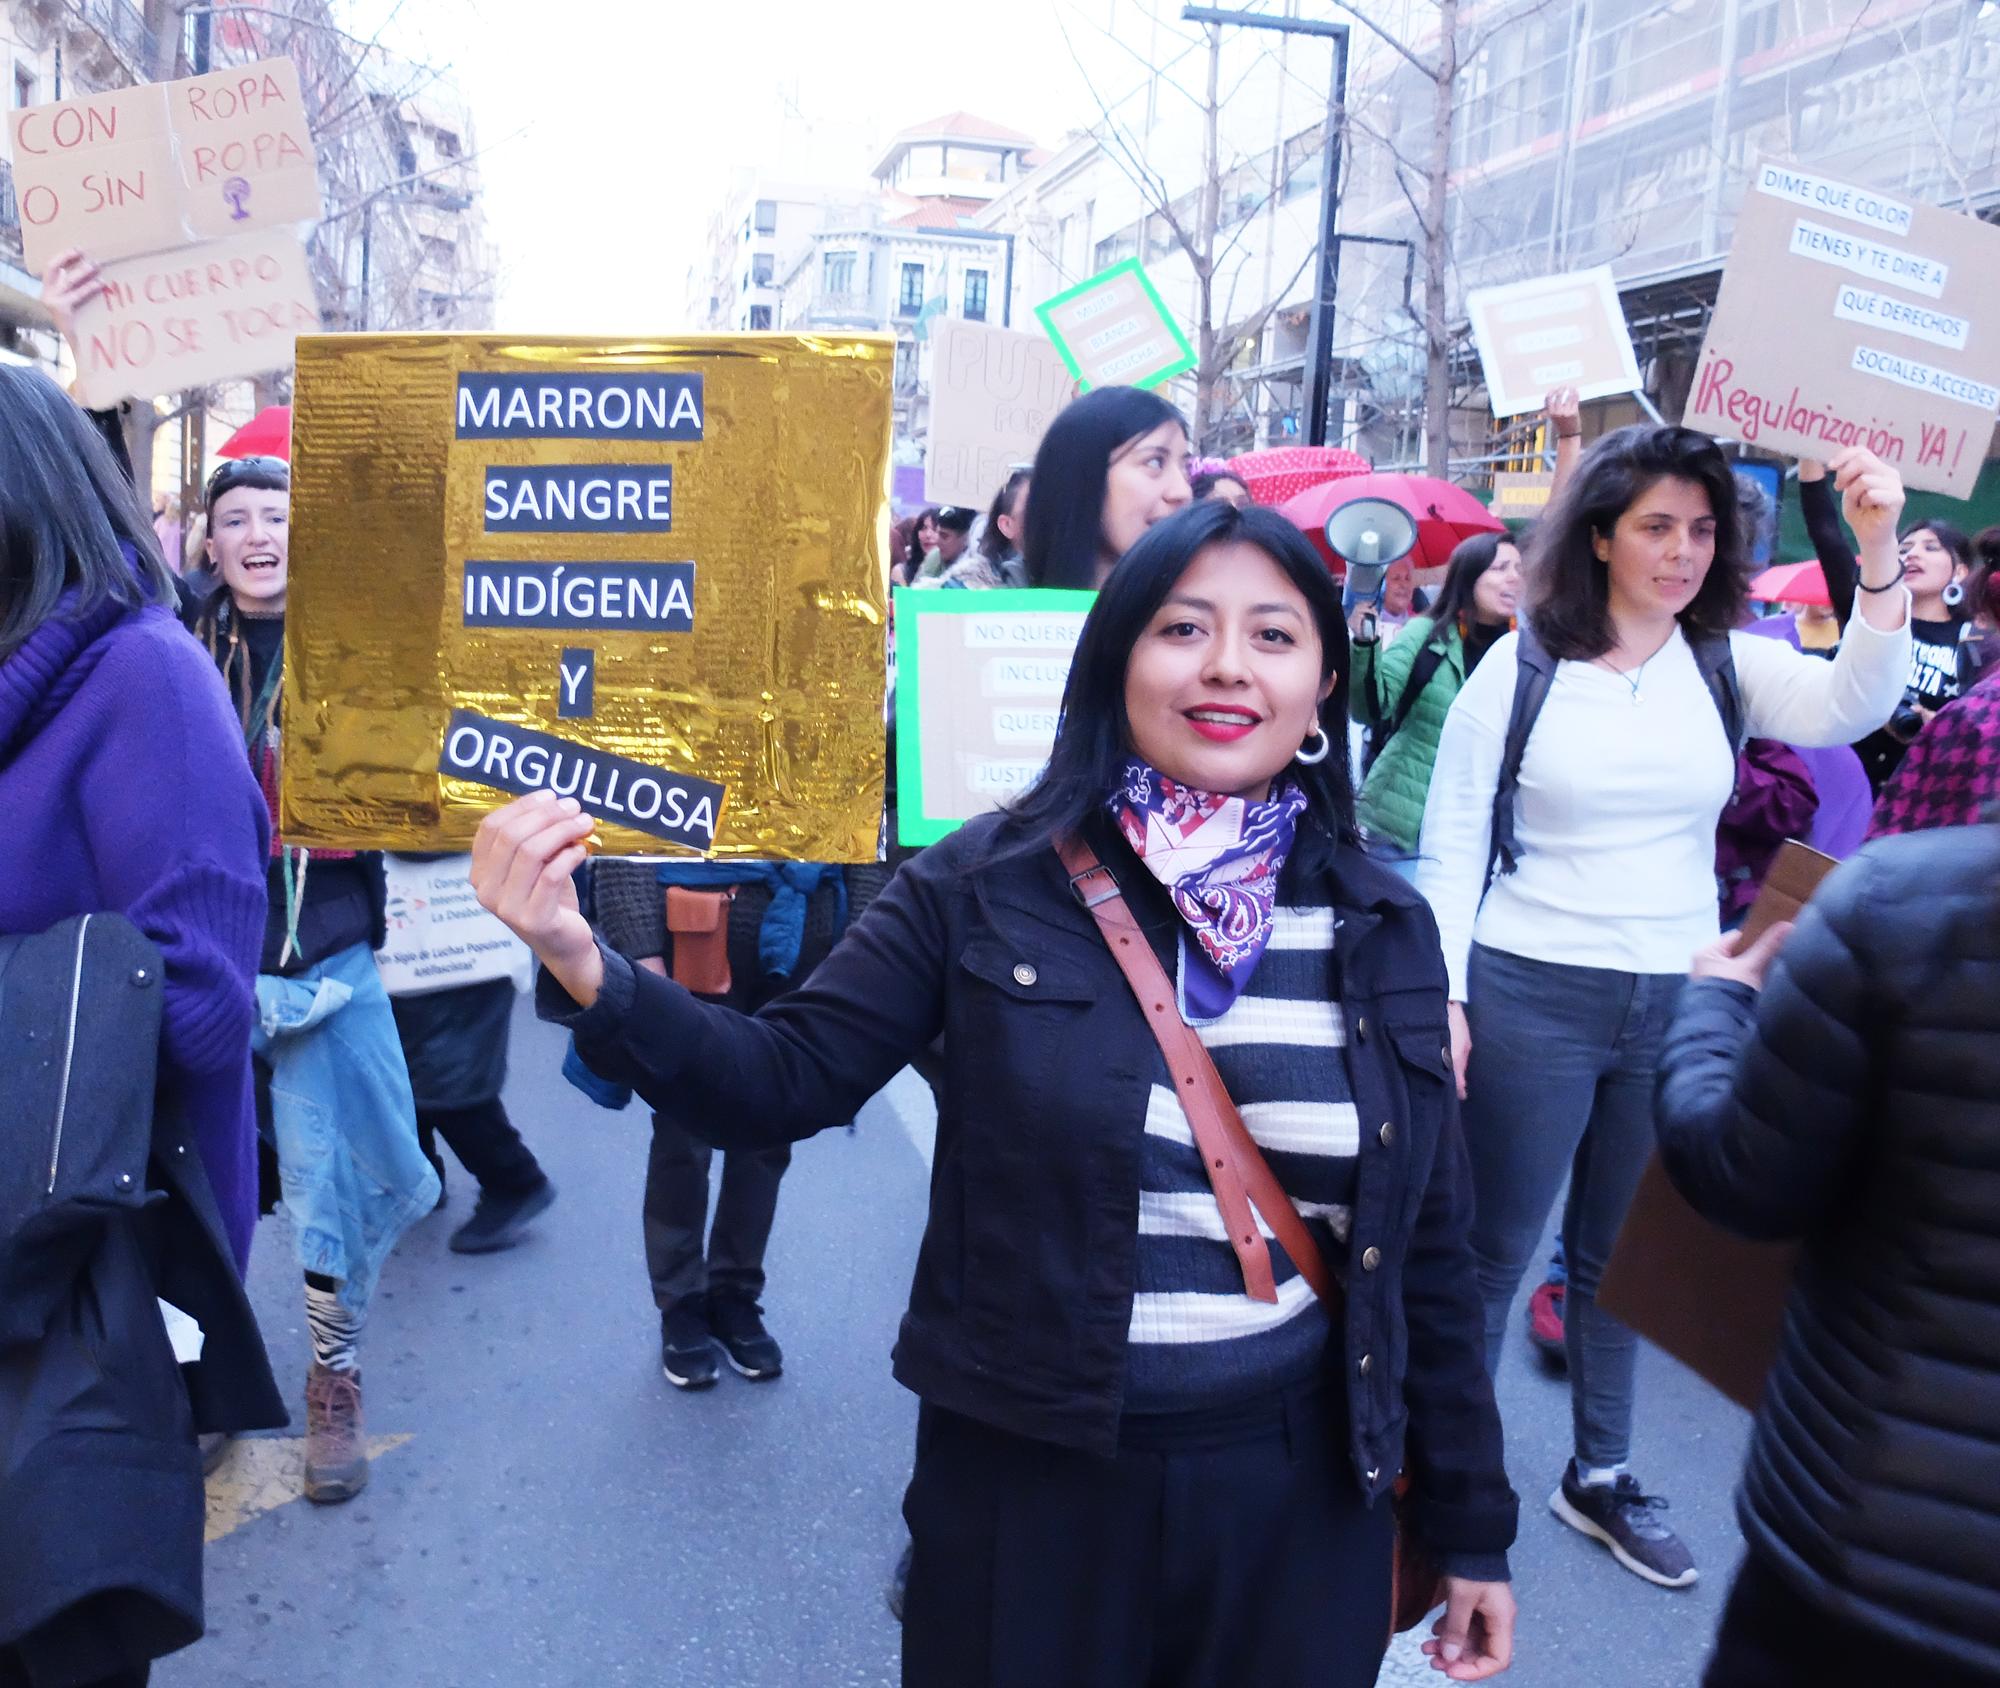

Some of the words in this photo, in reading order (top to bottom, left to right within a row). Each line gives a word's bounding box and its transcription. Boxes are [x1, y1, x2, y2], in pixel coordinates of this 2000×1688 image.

[18, 107, 116, 154] CON
[188, 73, 286, 121] ROPA
[23, 185, 59, 225] O
[193, 131, 305, 181] ROPA
[1765, 169, 1811, 198] DIME
[1855, 196, 1909, 227] COLOR
[101, 280, 136, 312] MI
[144, 254, 282, 305] CUERPO
[1797, 227, 1852, 259] TIENES
[1857, 245, 1868, 262] Y
[1871, 249, 1889, 270] TE
[1892, 256, 1929, 282] DIRÉ
[1931, 269, 1943, 285] A
[90, 320, 156, 371] NO
[163, 317, 204, 357] SE
[219, 299, 321, 344] TOCA
[1090, 320, 1137, 349] BLANCA
[1881, 302, 1961, 337] DERECHOS
[1856, 349, 1928, 385] SOCIALES
[1930, 373, 1996, 406] ACCEDES
[458, 387, 702, 430] MARRONA
[486, 479, 671, 521] SANGRE
[466, 566, 693, 621] INDÍGENA
[975, 625, 1004, 641] NO
[560, 663, 588, 706] Y
[999, 713, 1056, 732] QUER
[449, 726, 715, 840] ORGULLOSA
